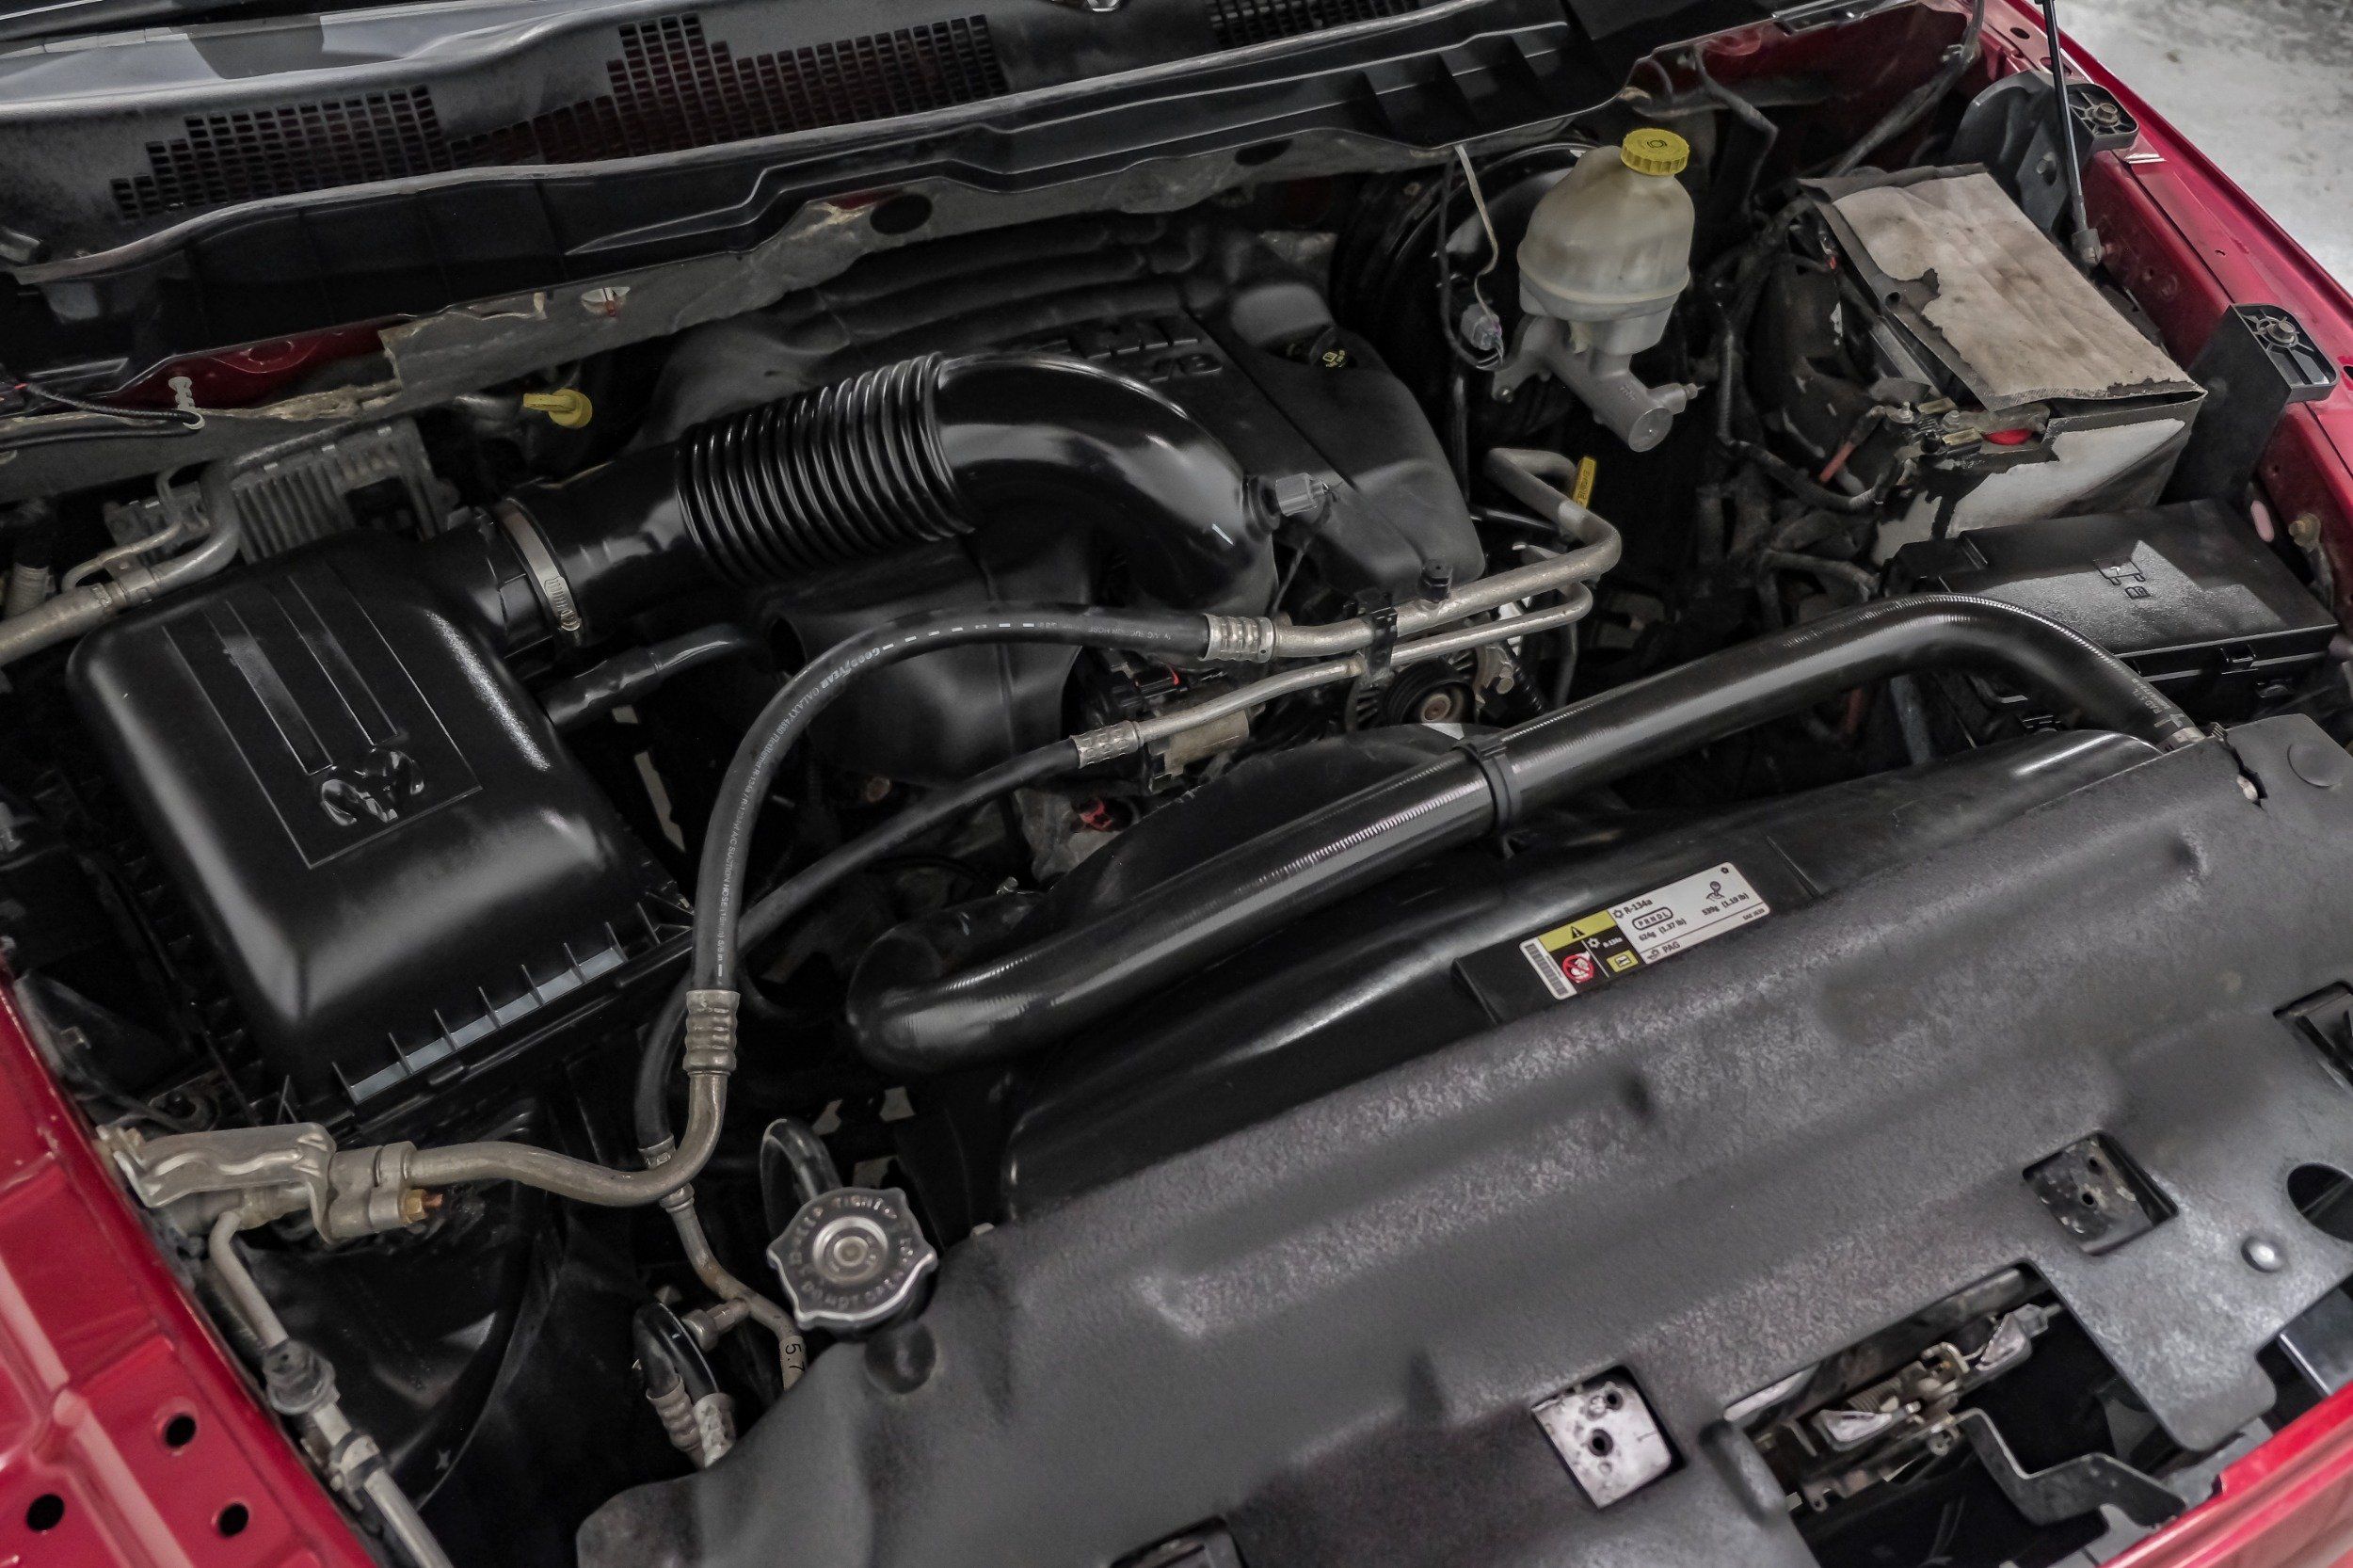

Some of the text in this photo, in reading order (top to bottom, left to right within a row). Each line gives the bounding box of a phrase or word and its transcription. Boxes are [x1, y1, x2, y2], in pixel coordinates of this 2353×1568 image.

[789, 687, 820, 721] GALAXY
[721, 884, 730, 907] HOSE
[1624, 899, 1654, 914] R-134a
[1661, 940, 1680, 953] PAG
[785, 1341, 806, 1373] 5.7
